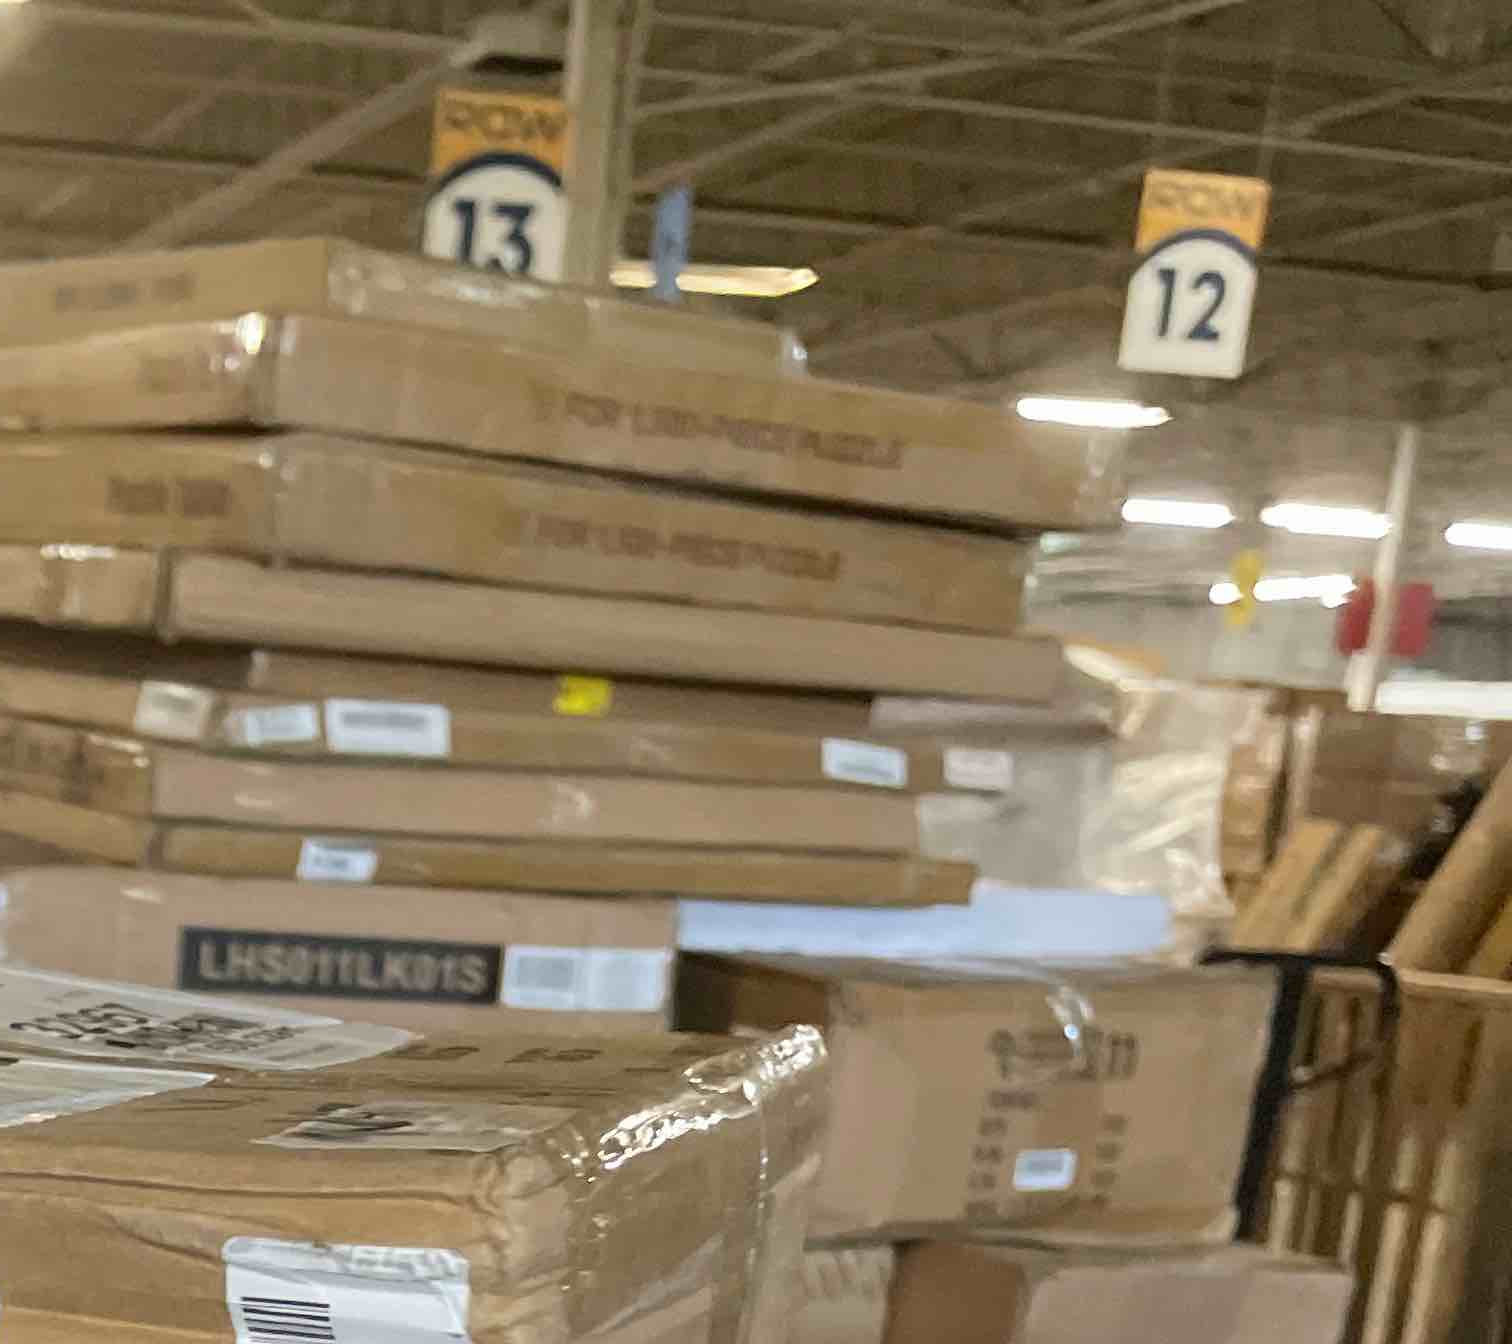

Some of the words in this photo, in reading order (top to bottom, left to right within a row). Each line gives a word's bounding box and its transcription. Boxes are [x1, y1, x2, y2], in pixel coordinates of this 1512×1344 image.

[443, 99, 569, 143] ROW
[453, 198, 535, 273] 13
[1156, 268, 1226, 341] 12
